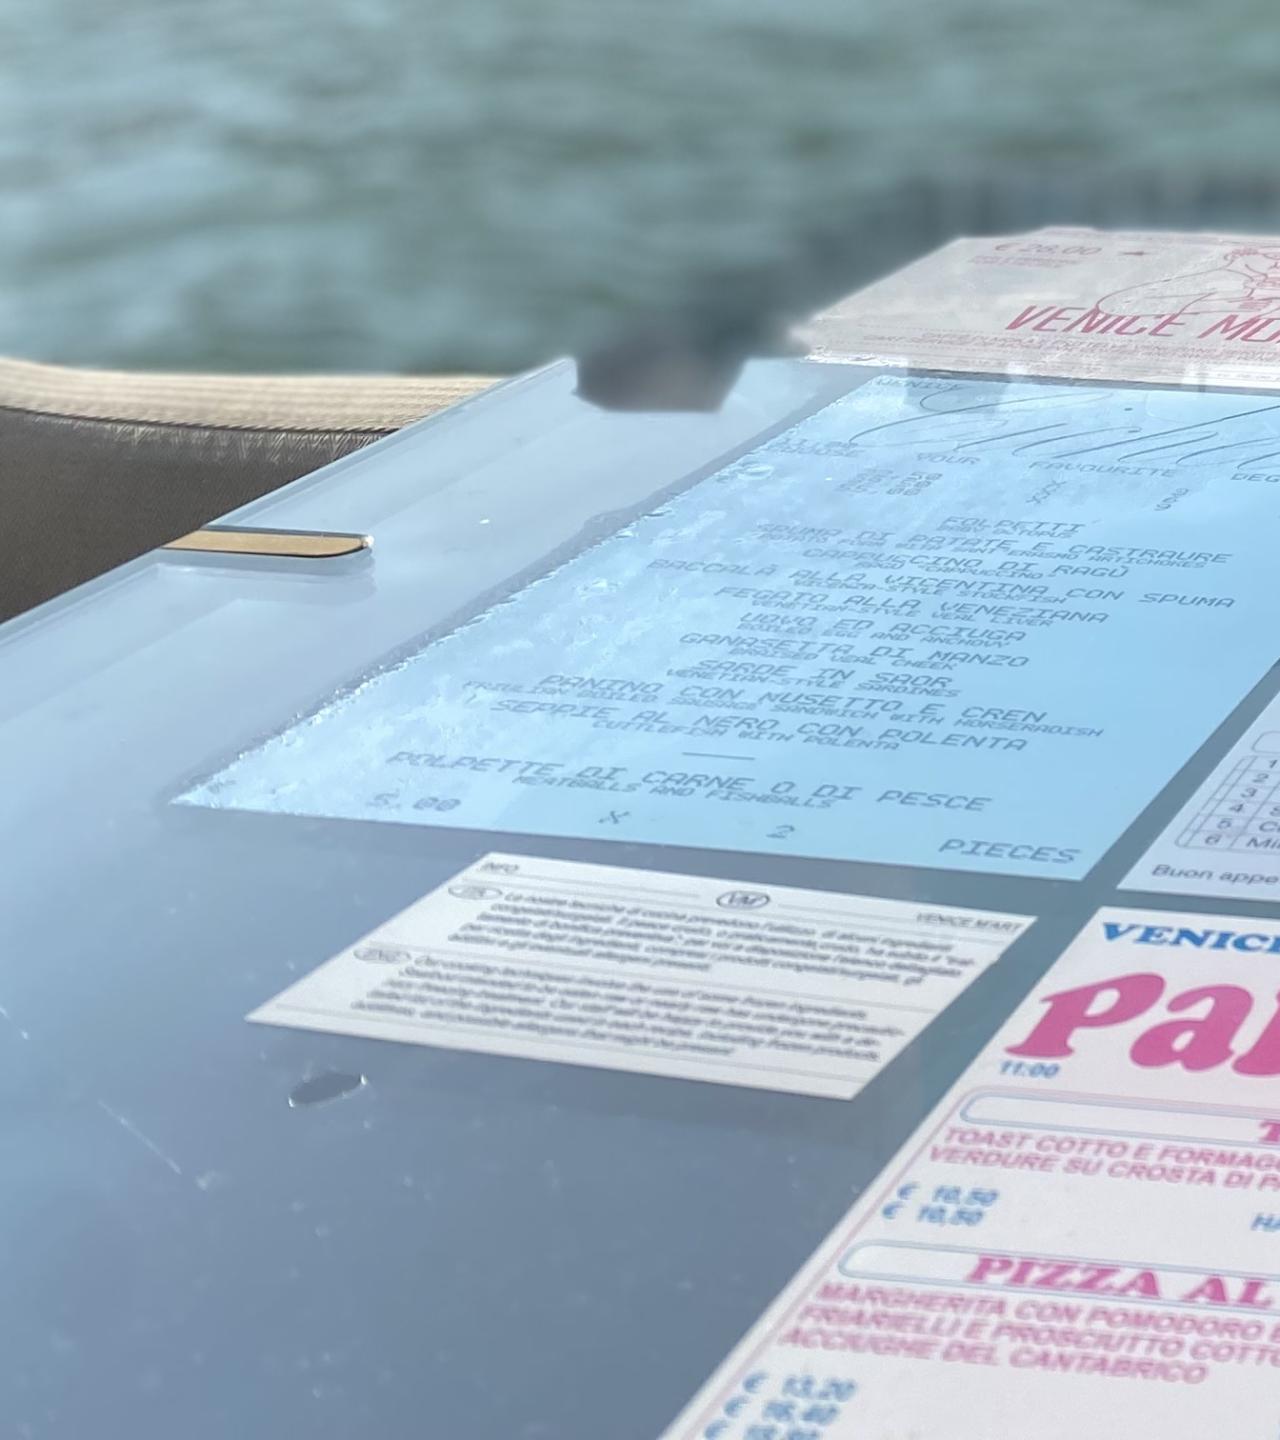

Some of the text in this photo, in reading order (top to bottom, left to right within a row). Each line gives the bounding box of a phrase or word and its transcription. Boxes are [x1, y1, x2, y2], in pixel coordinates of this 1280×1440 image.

[1004, 304, 1186, 337] VENICE
[713, 586, 1110, 624] FEGATO ALLA VENEZIANA
[788, 568, 868, 582] ALLA
[885, 575, 1049, 595] VICENTINA
[1065, 588, 1126, 601] CON
[1138, 591, 1236, 608] SPUMA
[809, 668, 856, 680] IN
[868, 671, 953, 689] SAOR
[631, 709, 671, 725] AL
[697, 713, 781, 731] NERO
[796, 721, 865, 738] CON
[878, 727, 1028, 752] POLENTA
[574, 764, 628, 782] DI
[641, 769, 756, 793] CARNE
[811, 783, 862, 801] DI
[875, 789, 993, 813] PESCE
[938, 837, 1083, 865] PIECES
[1150, 863, 1214, 881] Buon
[1000, 1060, 1061, 1079] 11:00
[943, 1126, 1034, 1151] TOAST
[1036, 1133, 1130, 1159] COTTO
[1134, 1141, 1156, 1159] E
[929, 1145, 1058, 1174] VERDURE
[1062, 1156, 1100, 1176] SU
[1107, 1161, 1216, 1188] CROSTA
[1223, 1170, 1254, 1190] DI
[965, 1254, 1161, 1300] PIZZA
[1180, 1275, 1274, 1310] AL
[816, 1281, 1007, 1317] MARGHERITA
[1014, 1298, 1083, 1324] CON
[1085, 1304, 1265, 1342] POMODORO
[941, 1340, 1001, 1366] DEL
